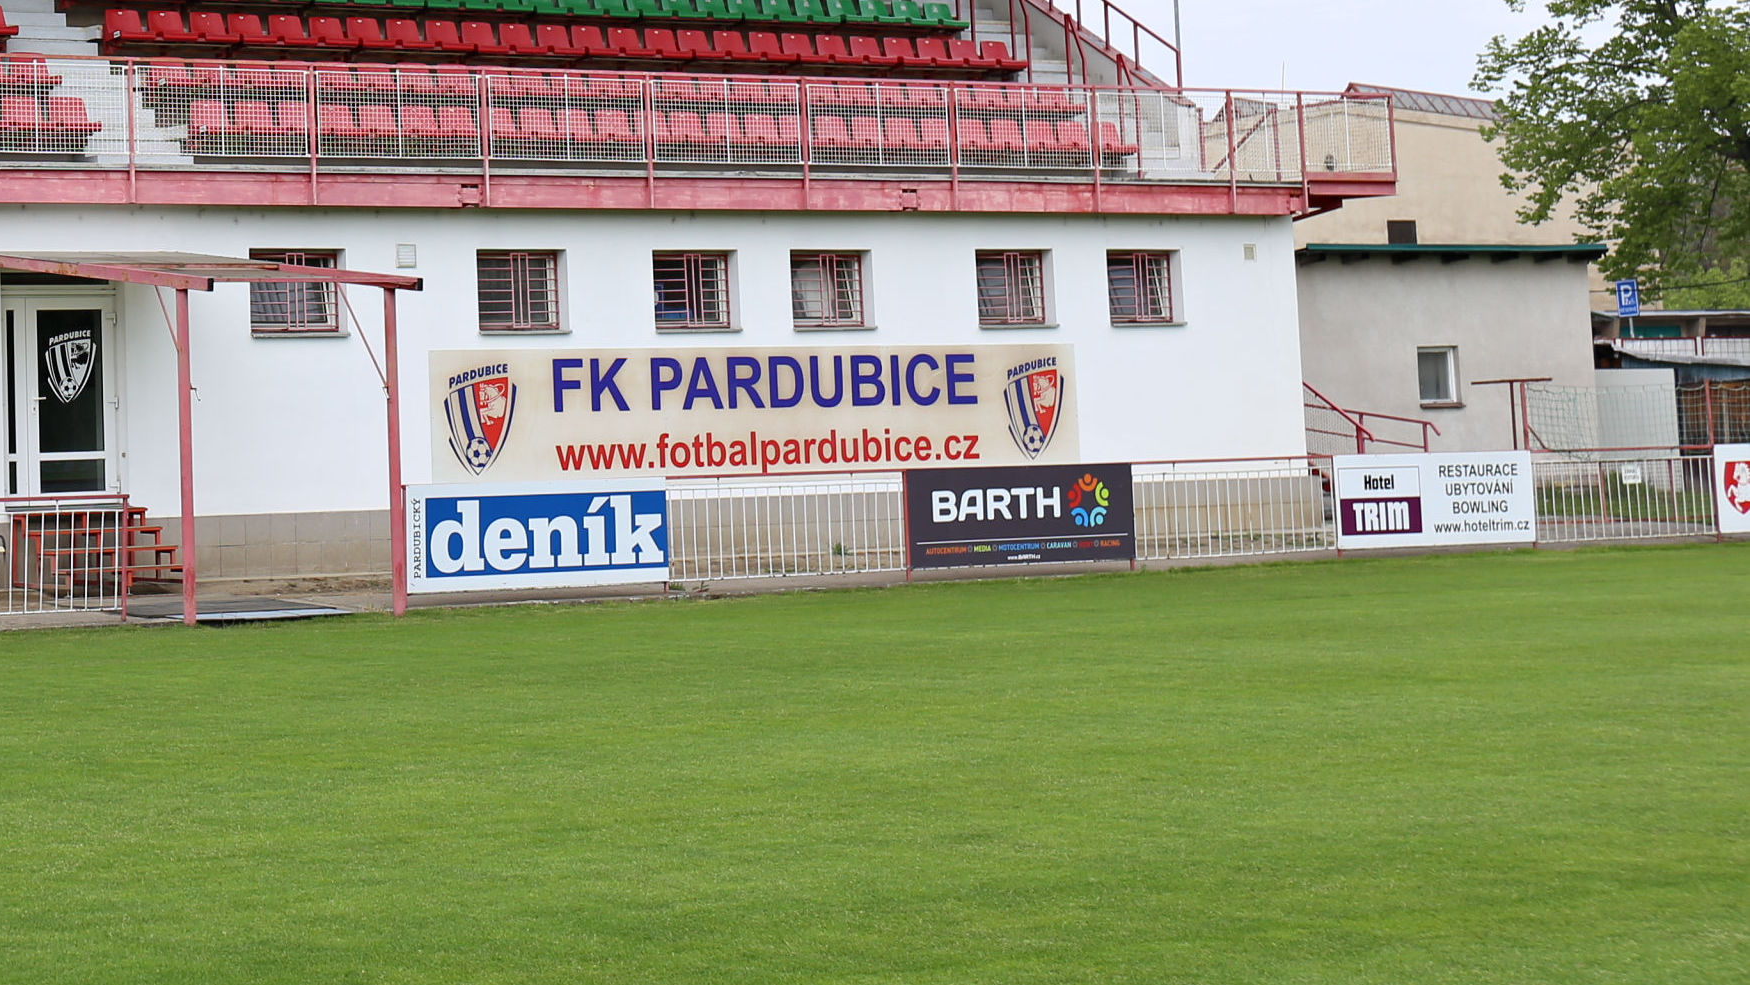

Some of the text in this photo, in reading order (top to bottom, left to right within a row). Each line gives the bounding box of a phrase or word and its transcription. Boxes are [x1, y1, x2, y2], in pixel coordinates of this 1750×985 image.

[1620, 284, 1633, 306] P
[49, 329, 91, 346] PARDUBICE
[449, 363, 509, 389] PARDUBICE
[1007, 357, 1057, 380] PARDUBICE
[552, 354, 978, 413] FK PARDUBICE
[556, 428, 981, 473] www.fotbalpardubice.cz
[1439, 463, 1518, 478] RESTAURACE
[1364, 474, 1394, 490] Hotel
[1445, 479, 1513, 496] UBYTOVÁNÍ
[931, 486, 1062, 523] BARTH
[1453, 500, 1508, 514] BOWLING
[1353, 500, 1411, 532] TRIM
[1434, 518, 1530, 534] www.hoteltrim.cz
[411, 498, 421, 578] PARDUBICKÝ
[430, 494, 665, 574] deník
[974, 544, 992, 553] MEDIA
[1046, 541, 1072, 549] CARAVAN
